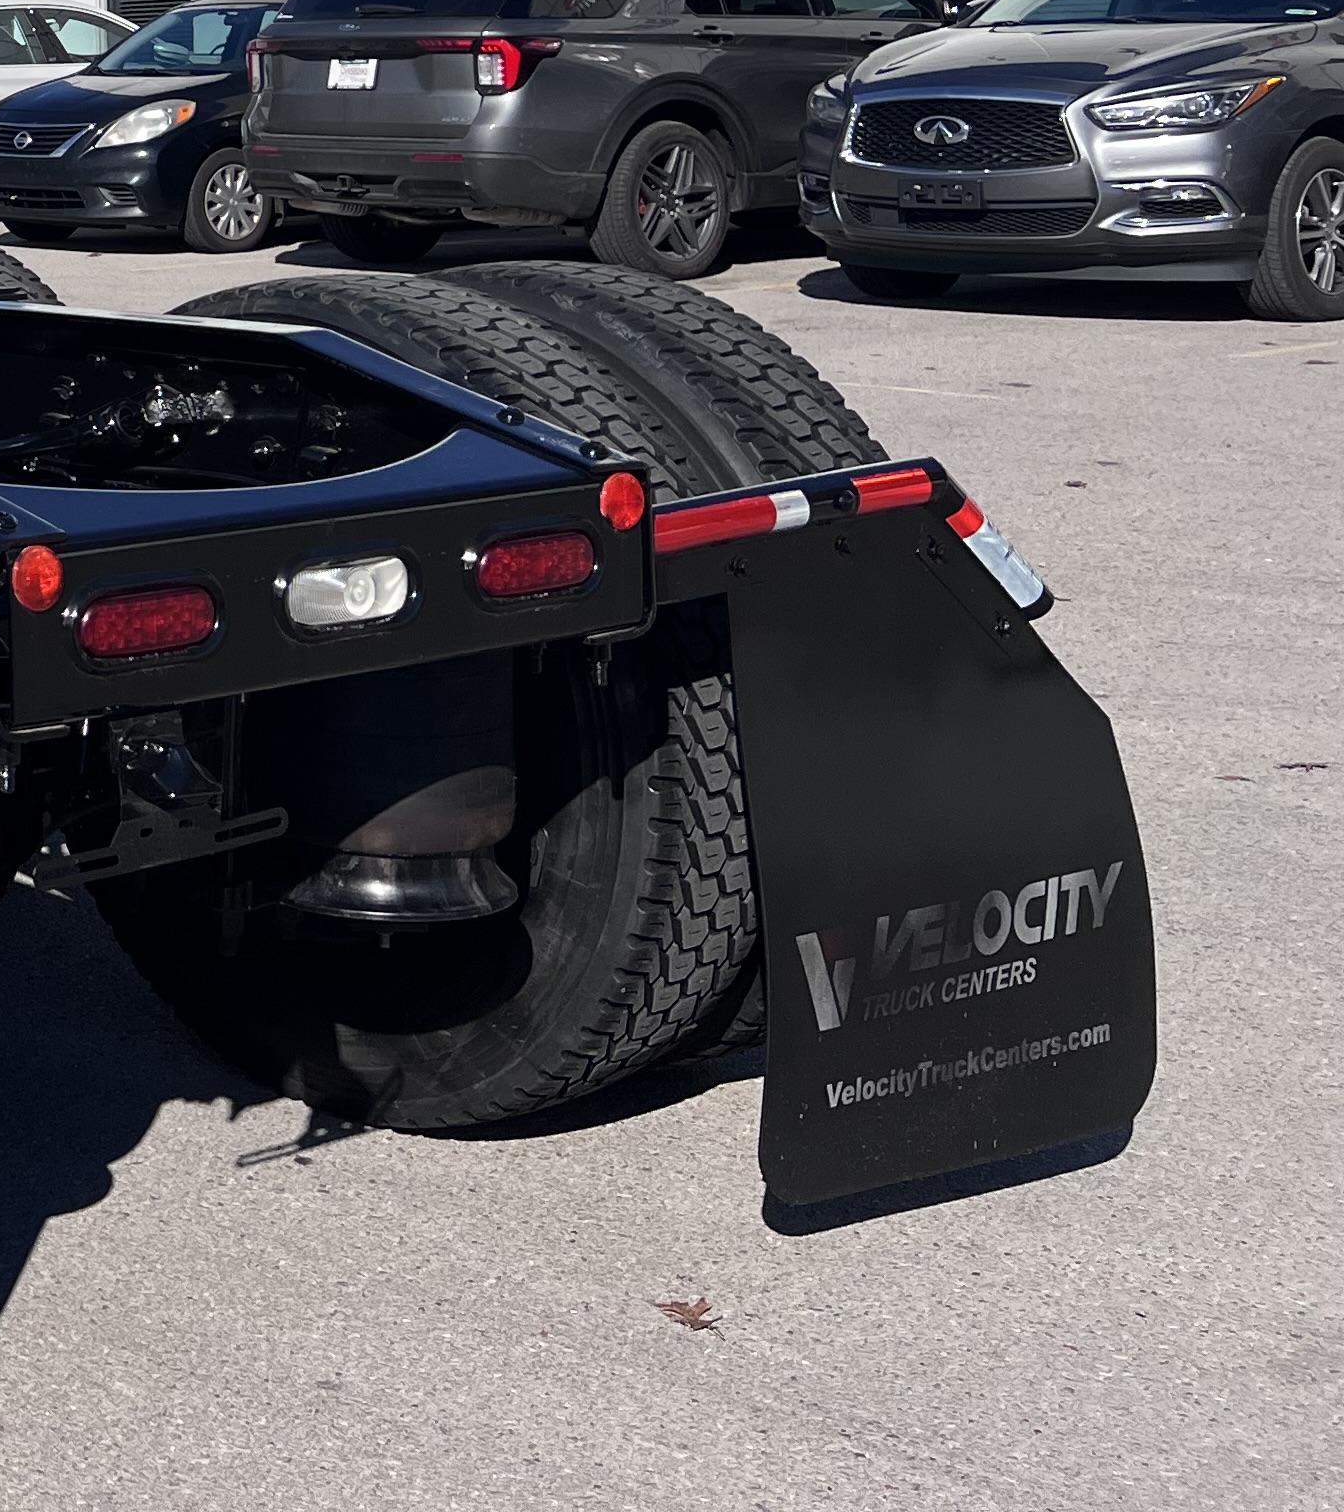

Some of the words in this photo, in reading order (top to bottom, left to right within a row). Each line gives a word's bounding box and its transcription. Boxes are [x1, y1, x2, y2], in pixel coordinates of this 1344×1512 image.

[869, 860, 1124, 980] VELOCITY
[861, 981, 937, 1022] TRUCK
[940, 956, 1038, 1004] CENTERS
[825, 1021, 1111, 1109] VelocityTruckCenters.com
